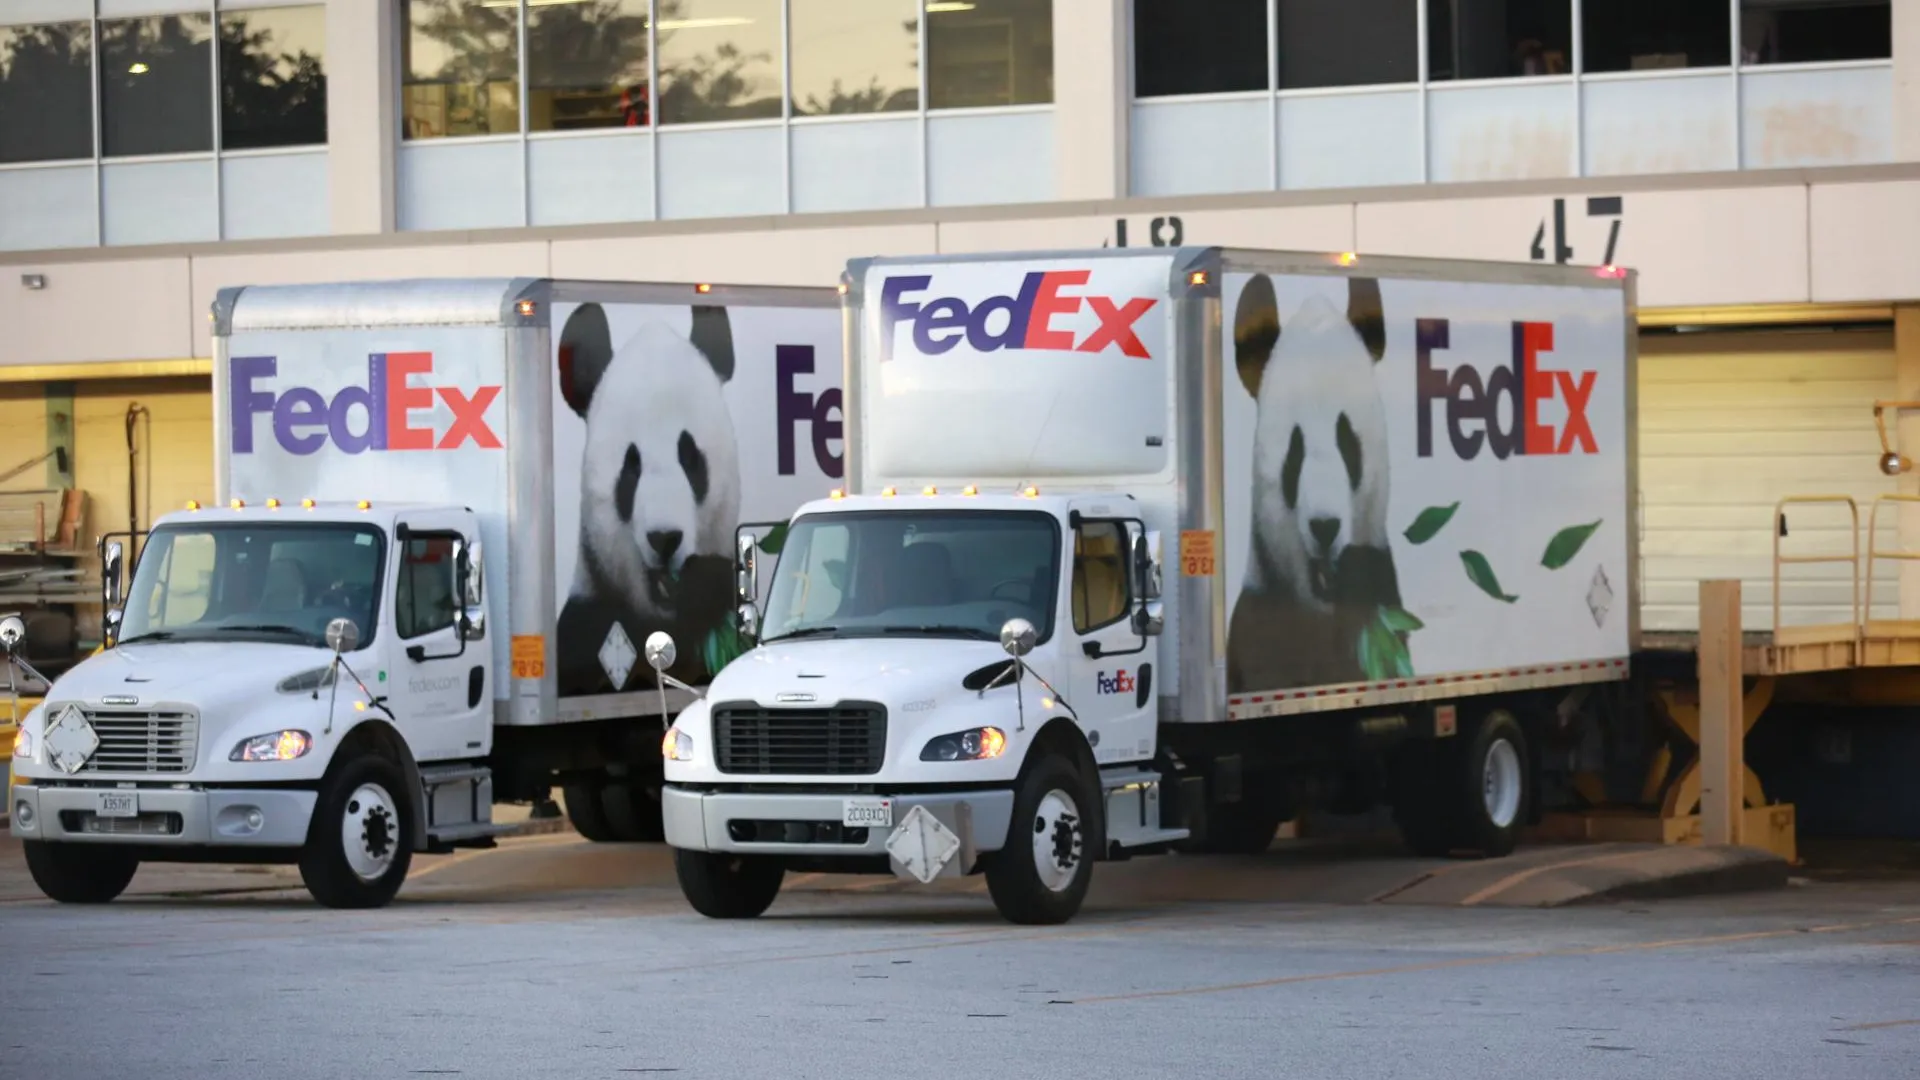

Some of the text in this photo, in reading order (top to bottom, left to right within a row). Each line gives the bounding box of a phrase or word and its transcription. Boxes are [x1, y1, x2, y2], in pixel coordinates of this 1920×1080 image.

[1530, 196, 1623, 266] 47
[881, 269, 1158, 361] FedEx
[230, 351, 504, 455] FedEx
[1416, 318, 1598, 460] FedEx
[408, 675, 461, 695] fedex.com
[1097, 669, 1135, 694] FedEx
